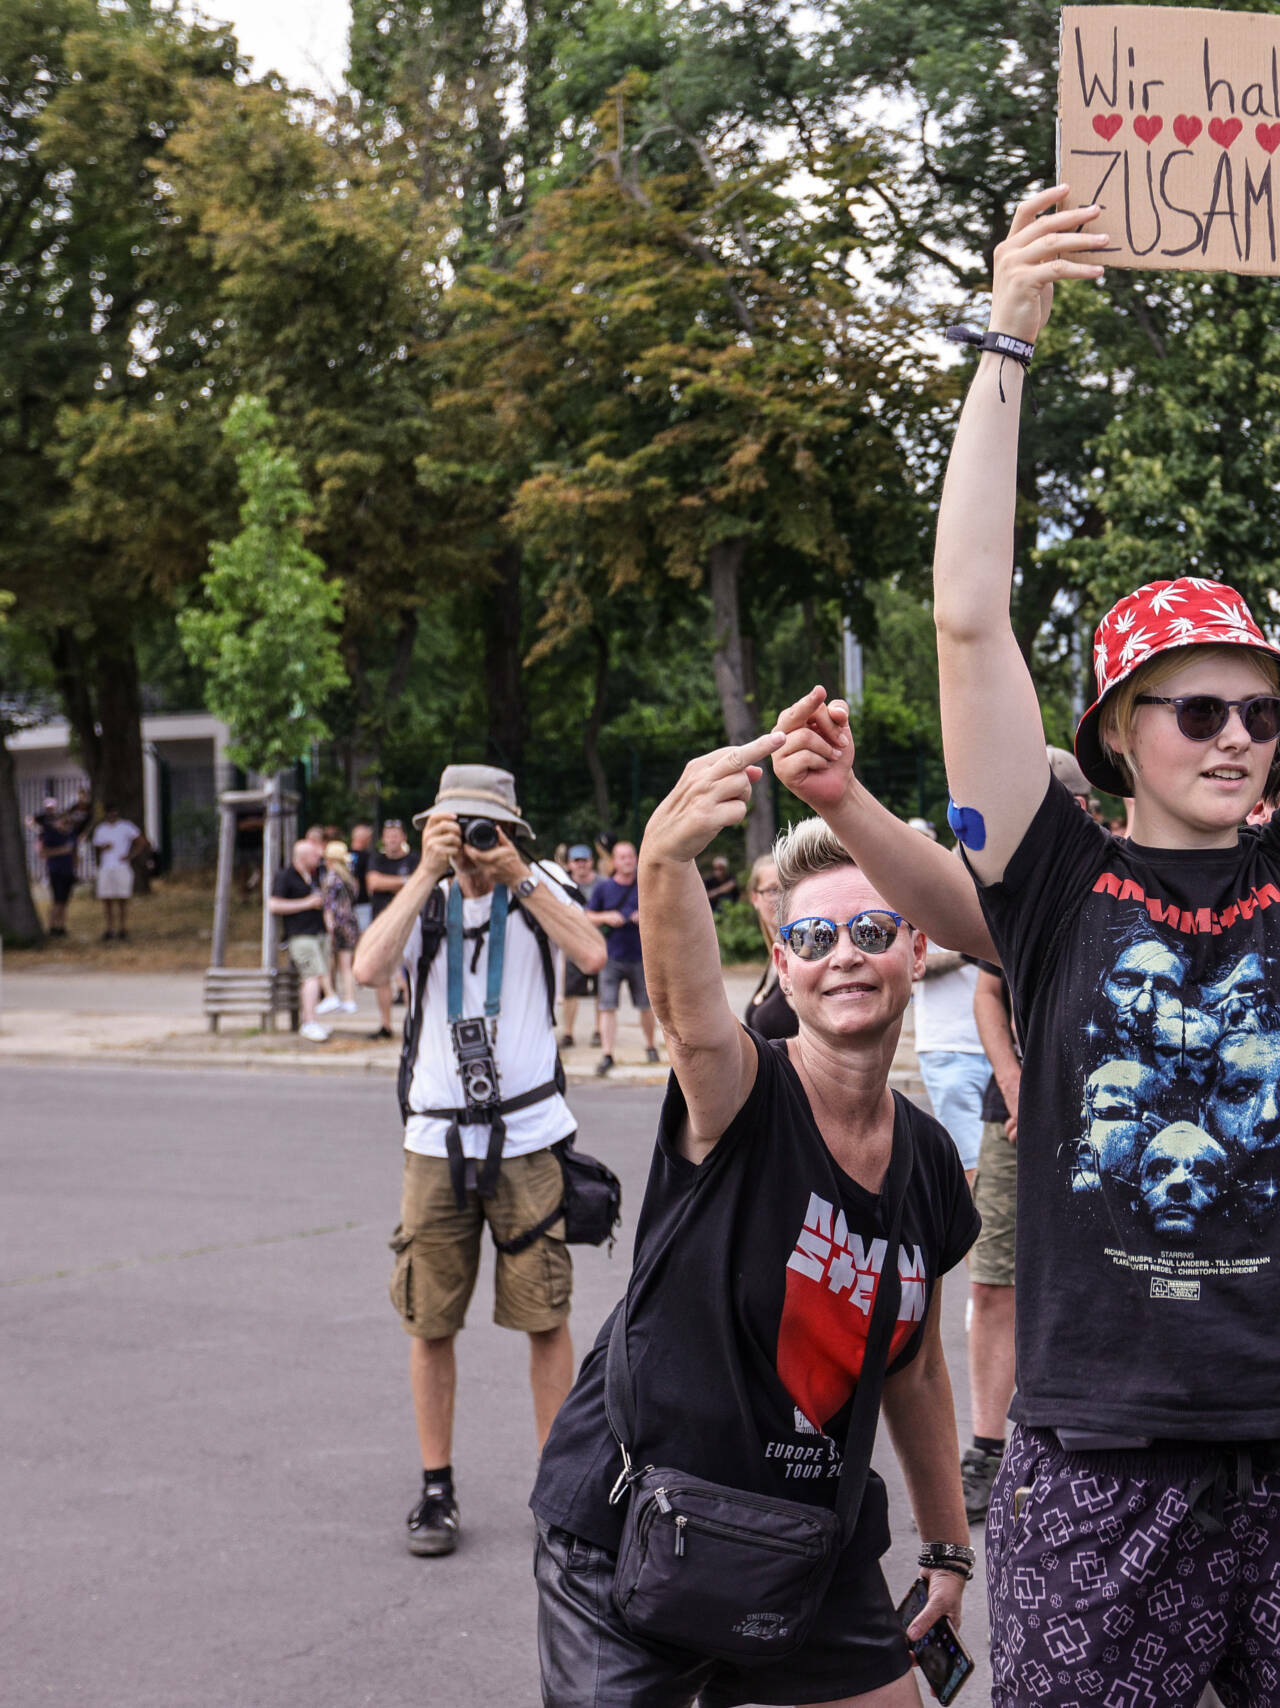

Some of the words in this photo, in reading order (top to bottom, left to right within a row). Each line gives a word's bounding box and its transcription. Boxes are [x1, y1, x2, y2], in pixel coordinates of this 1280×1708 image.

[1075, 26, 1165, 112] Wir
[1160, 1250, 1194, 1259] STARRING
[1157, 1257, 1175, 1267] PAUL
[1176, 1260, 1209, 1268] LANDERS
[1215, 1259, 1231, 1267] TILL
[1231, 1256, 1271, 1267] LINDEMANN
[1177, 1267, 1219, 1276] CHRISTOPH
[1219, 1265, 1259, 1275] SCHNEIDER
[764, 1441, 824, 1462] EUROPE
[784, 1463, 822, 1479] TOUR
